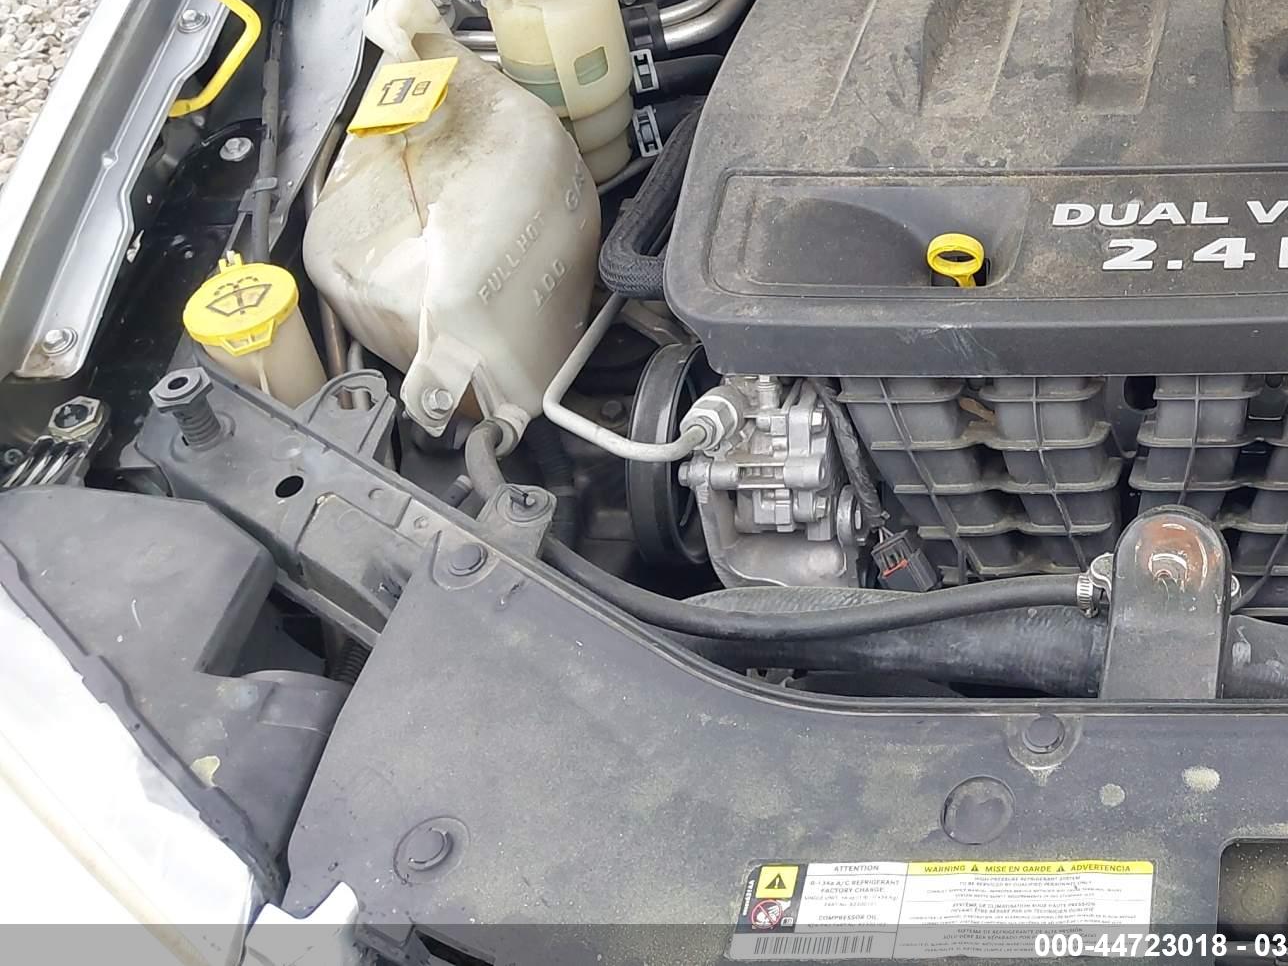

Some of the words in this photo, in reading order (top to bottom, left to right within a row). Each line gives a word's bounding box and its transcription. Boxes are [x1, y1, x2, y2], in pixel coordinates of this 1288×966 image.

[1052, 201, 1229, 227] DUAL
[478, 253, 520, 305] FULL
[515, 210, 544, 253] HOT
[1102, 237, 1256, 271] 2.4
[533, 258, 567, 307] ADD
[1070, 863, 1131, 872] ADVERTENCIA
